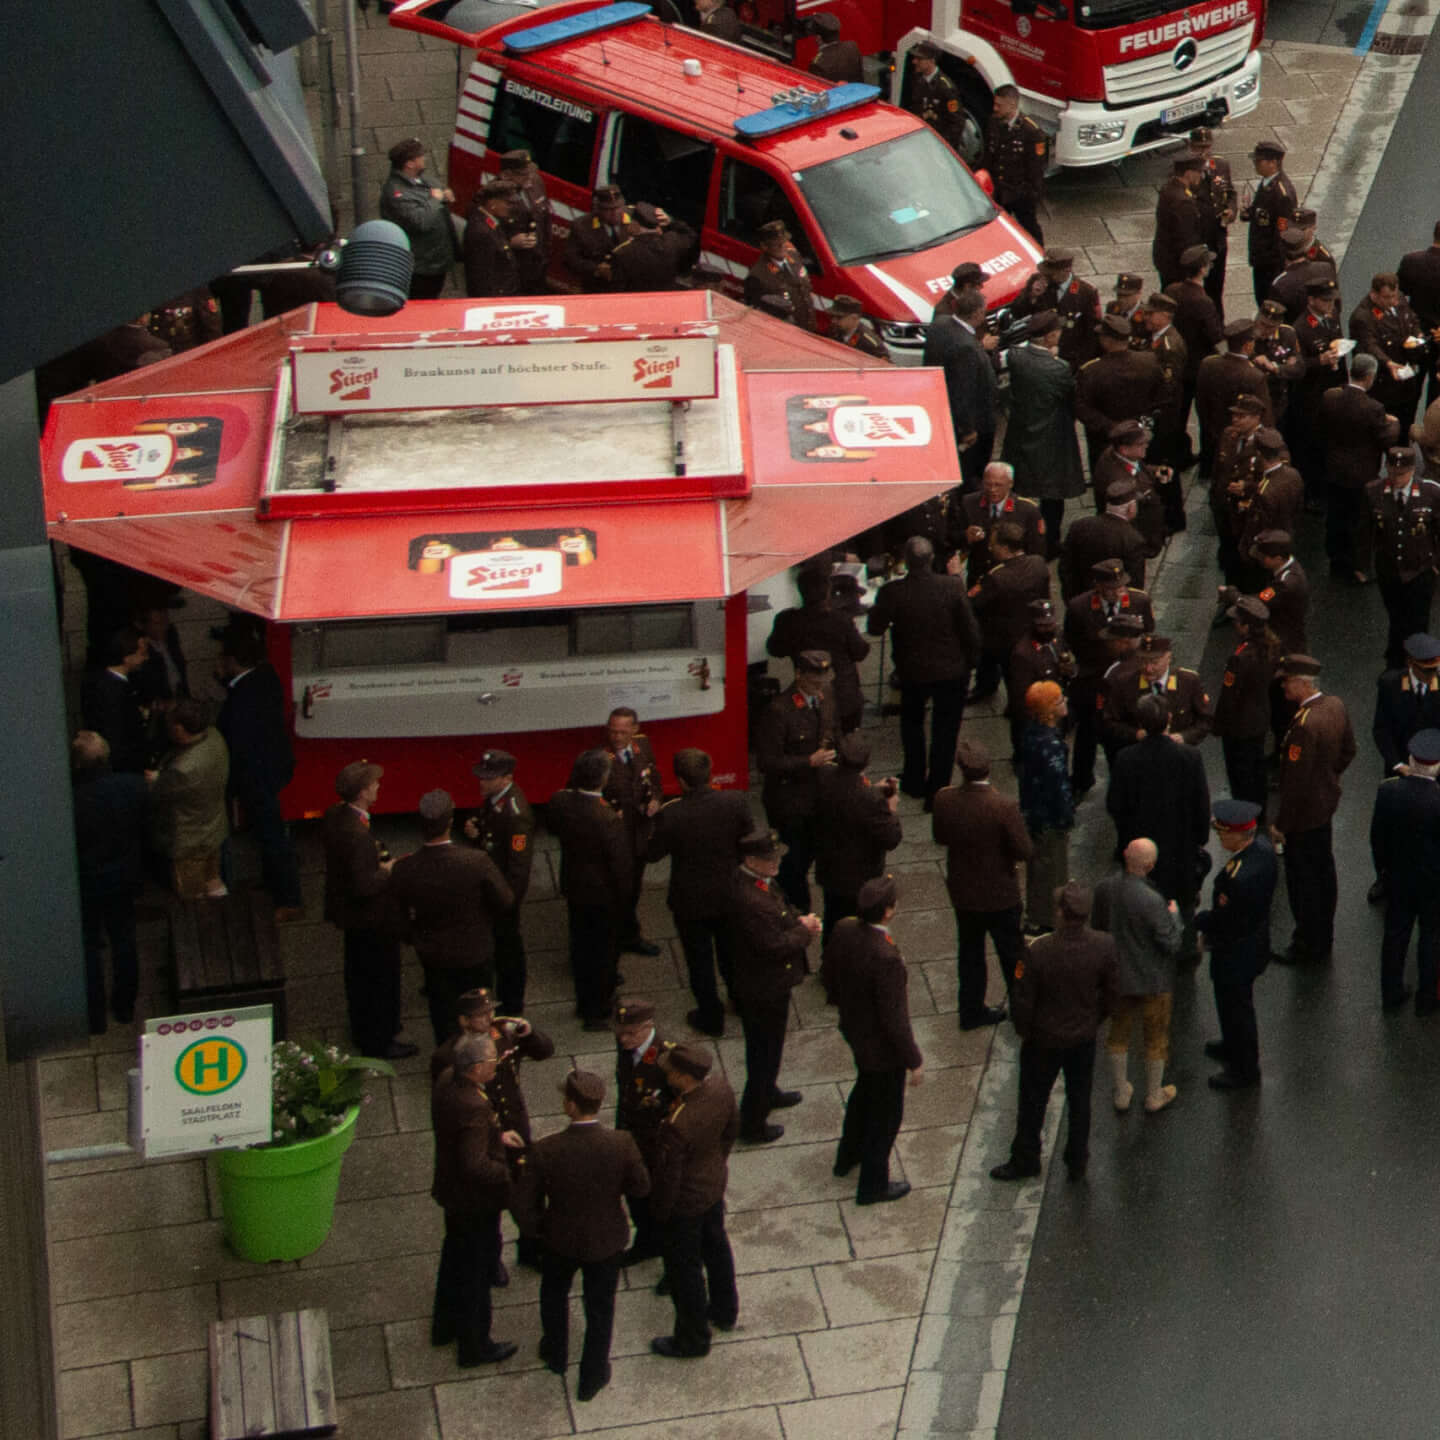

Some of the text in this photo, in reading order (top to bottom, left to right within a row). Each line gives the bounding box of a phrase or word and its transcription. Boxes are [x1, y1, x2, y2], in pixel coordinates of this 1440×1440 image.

[1119, 0, 1248, 53] FEUERWEHR
[505, 79, 592, 123] EINSATZLEITUNG
[925, 250, 1022, 294] FEWEHR
[329, 367, 378, 396] Stiegl
[403, 365, 477, 379] Braukunst
[480, 363, 505, 376] auf
[507, 360, 567, 375] höchster
[632, 356, 681, 384] Stiegl
[467, 563, 543, 587] Stiegl
[194, 1047, 229, 1086] H
[182, 1102, 241, 1116] SAALFELDEN
[182, 1111, 241, 1125] STADTPLATZ
